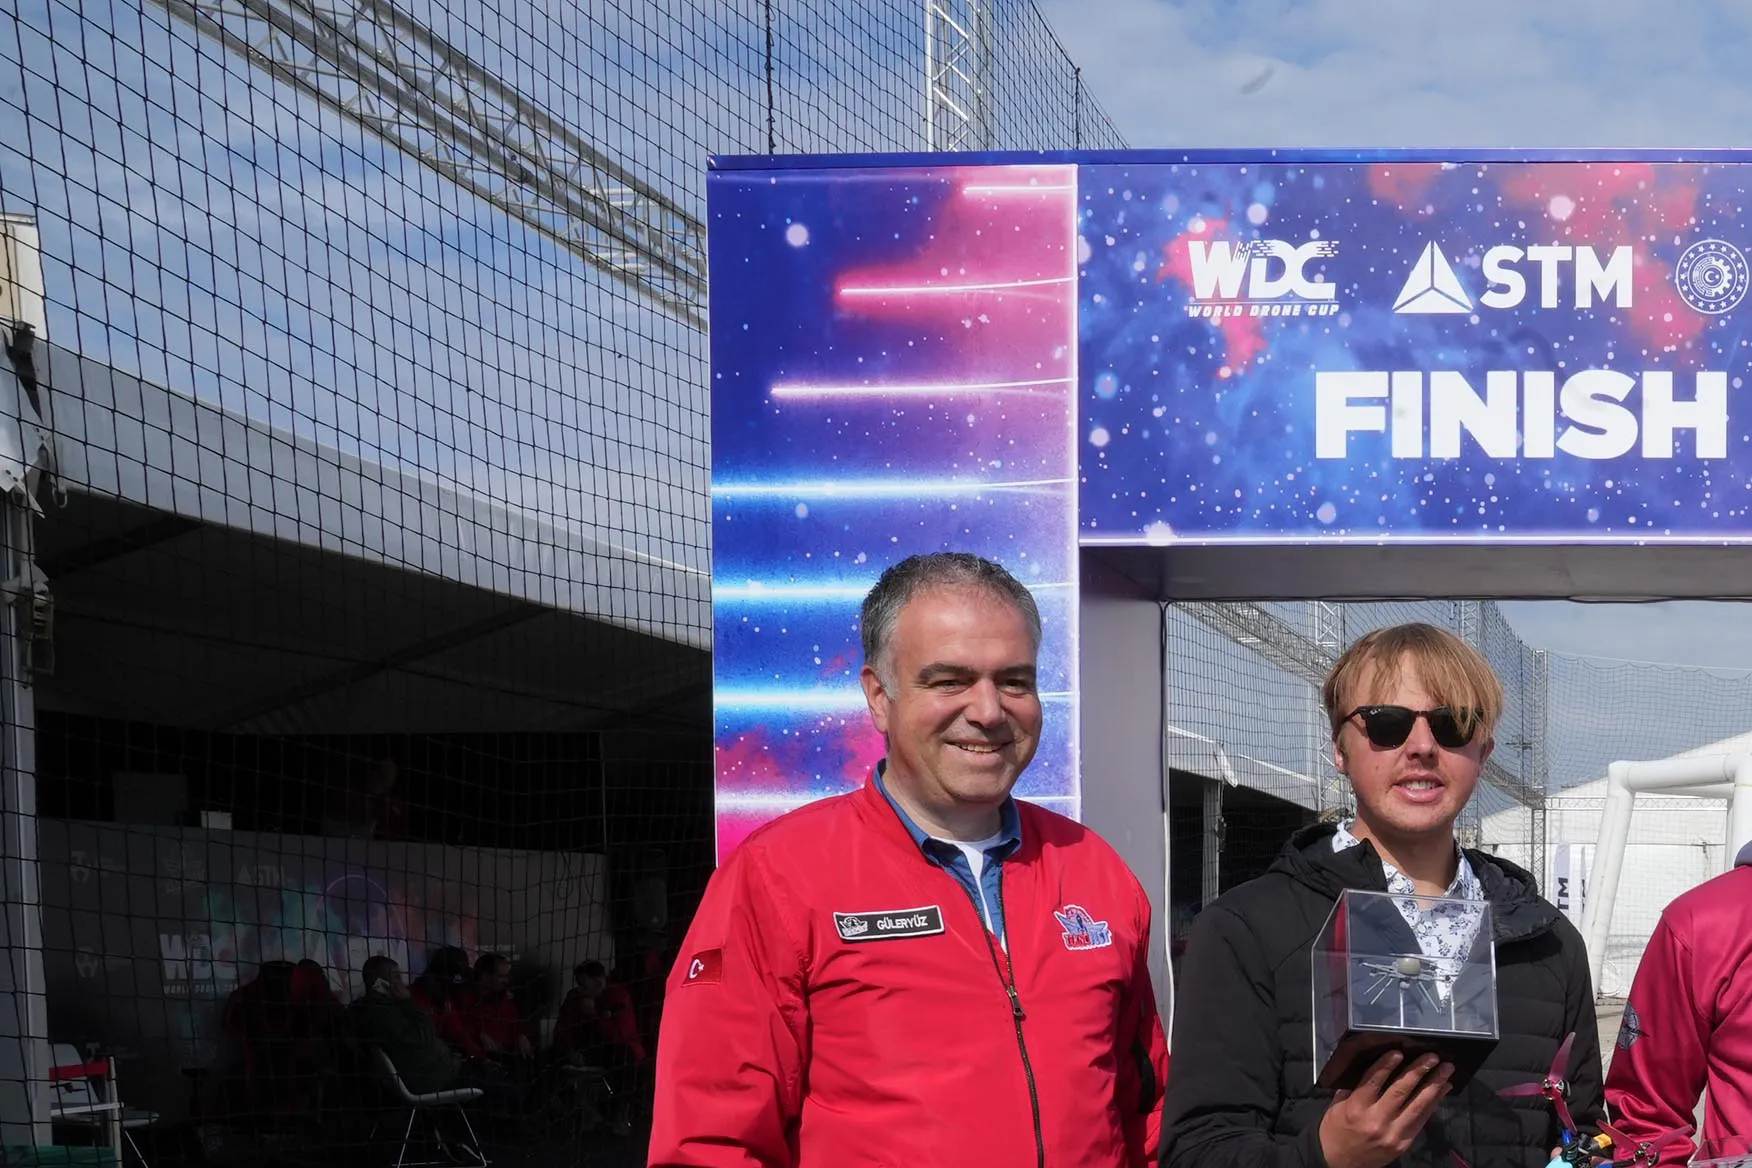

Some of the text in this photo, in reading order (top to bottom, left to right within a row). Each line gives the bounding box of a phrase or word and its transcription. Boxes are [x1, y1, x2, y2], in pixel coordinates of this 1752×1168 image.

[1188, 240, 1340, 300] WDC
[1479, 244, 1633, 309] STM
[1188, 303, 1340, 318] WORLD DRONE CUP
[1315, 369, 1728, 460] FINISH
[876, 914, 929, 930] GÜLERYÜZ
